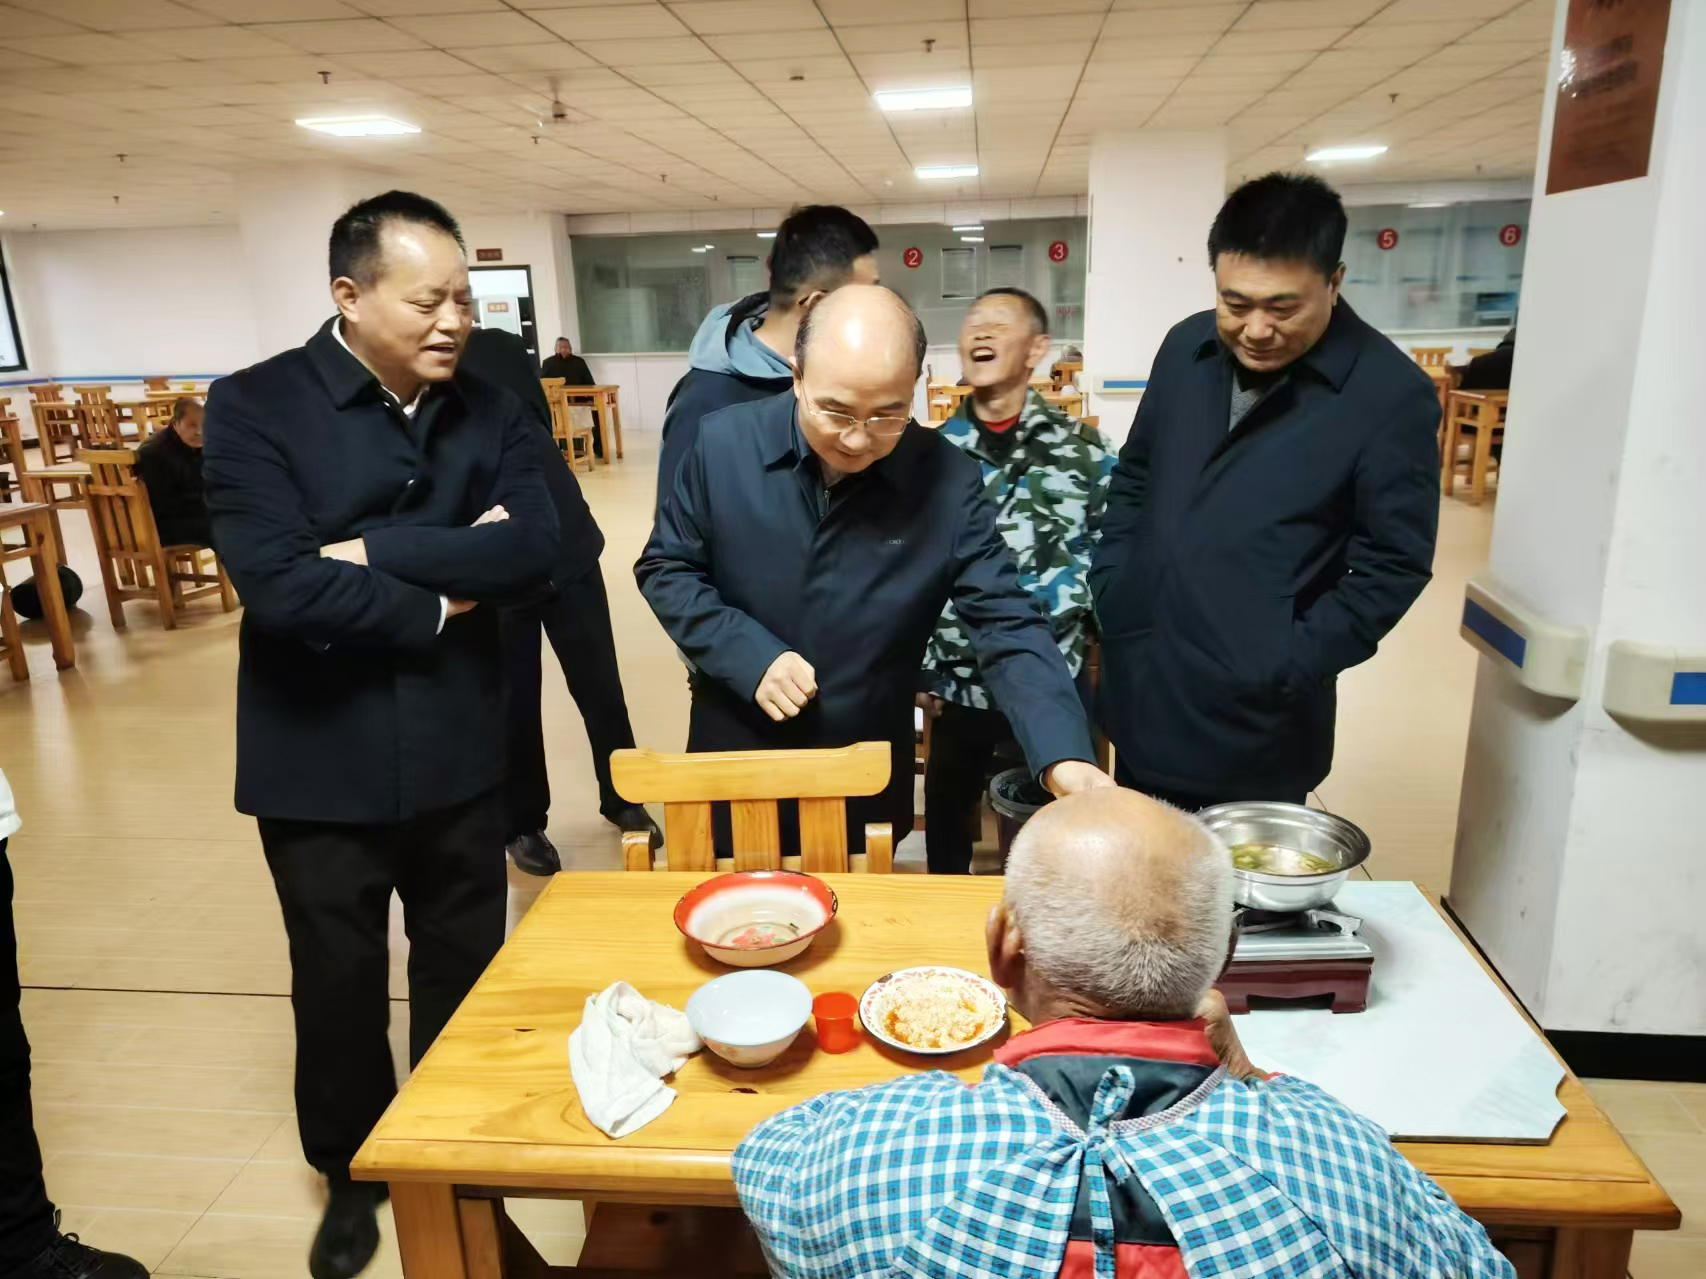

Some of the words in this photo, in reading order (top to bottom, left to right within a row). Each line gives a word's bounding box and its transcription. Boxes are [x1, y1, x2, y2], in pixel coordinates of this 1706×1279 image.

[1383, 231, 1393, 248] 5
[1504, 226, 1516, 244] 6
[908, 250, 919, 266] 2
[1054, 243, 1064, 260] 3
